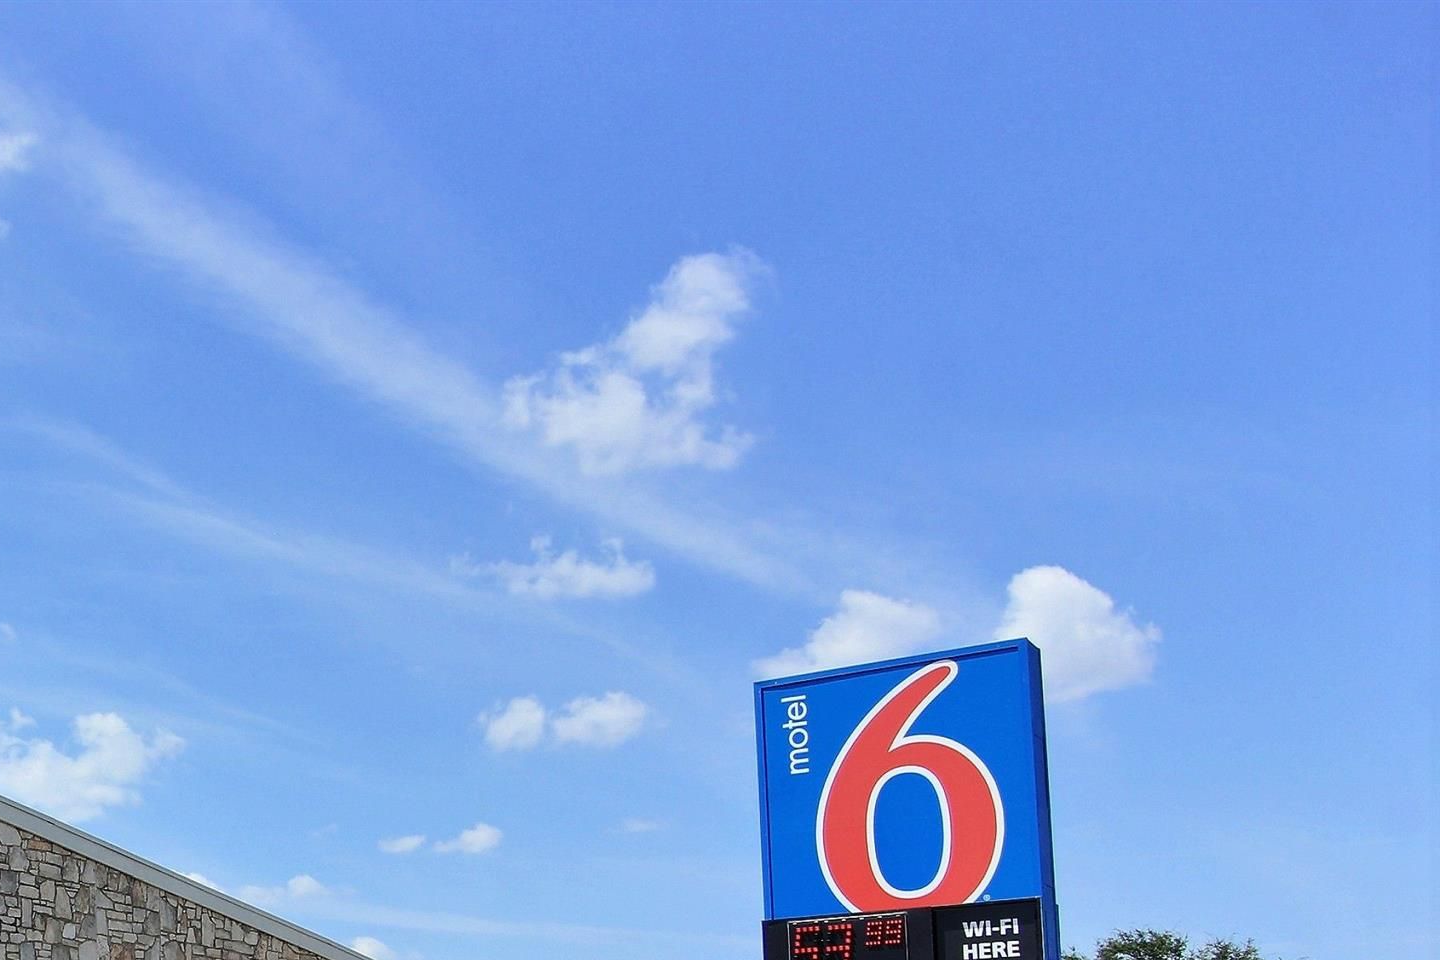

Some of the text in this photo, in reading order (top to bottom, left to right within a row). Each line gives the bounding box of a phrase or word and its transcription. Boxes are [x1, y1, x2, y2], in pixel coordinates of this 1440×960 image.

[780, 694, 810, 775] motel
[816, 660, 1005, 914] 6
[962, 918, 1019, 938] WI-FI
[963, 941, 1021, 960] HERE
